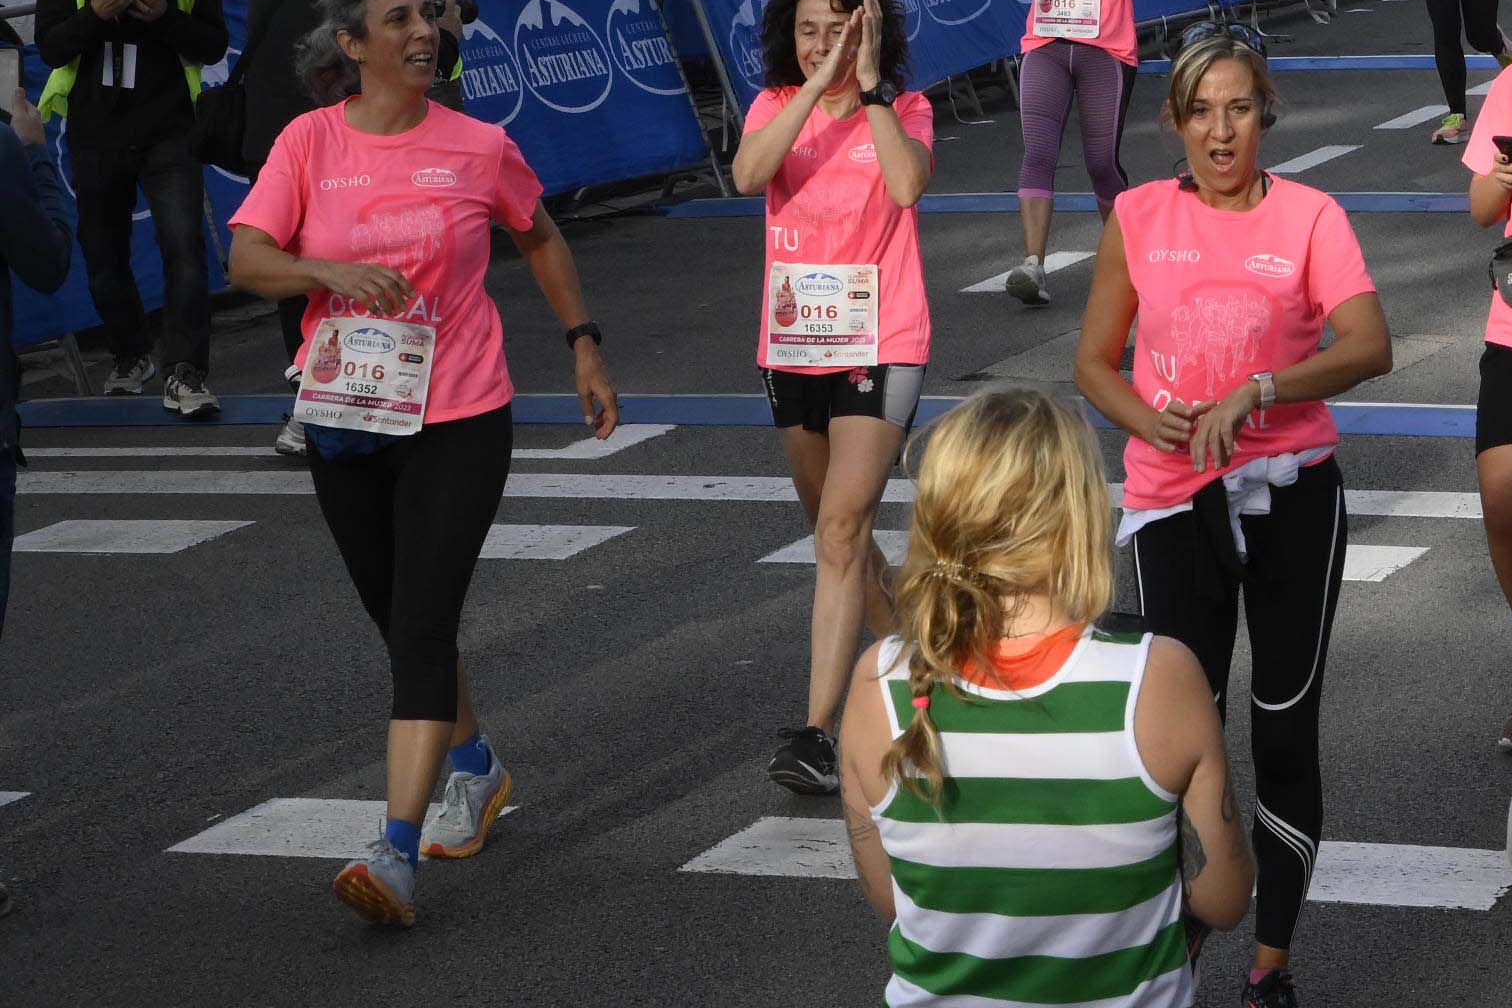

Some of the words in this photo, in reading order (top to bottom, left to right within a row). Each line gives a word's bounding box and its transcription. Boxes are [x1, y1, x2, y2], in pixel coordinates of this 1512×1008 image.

[1054, 0, 1077, 9] 016
[616, 27, 675, 72] ASTUR
[522, 42, 609, 88] ASTURIANA
[463, 62, 520, 101] URIANA
[319, 174, 371, 191] OYSHO
[769, 225, 800, 252] TU
[1149, 248, 1201, 263] OYSHO
[800, 281, 840, 291] ASTURIANA
[800, 304, 838, 320] 016
[803, 323, 834, 333] 16353
[348, 336, 392, 350] ASTURIANA
[343, 361, 385, 381] 016
[1150, 349, 1177, 383] TU
[345, 382, 378, 395] 16352
[312, 392, 344, 403] CARRERA
[345, 396, 356, 404] DE
[367, 399, 393, 409] MUJER
[305, 407, 343, 420] OYSHO
[372, 415, 412, 428] Santander
